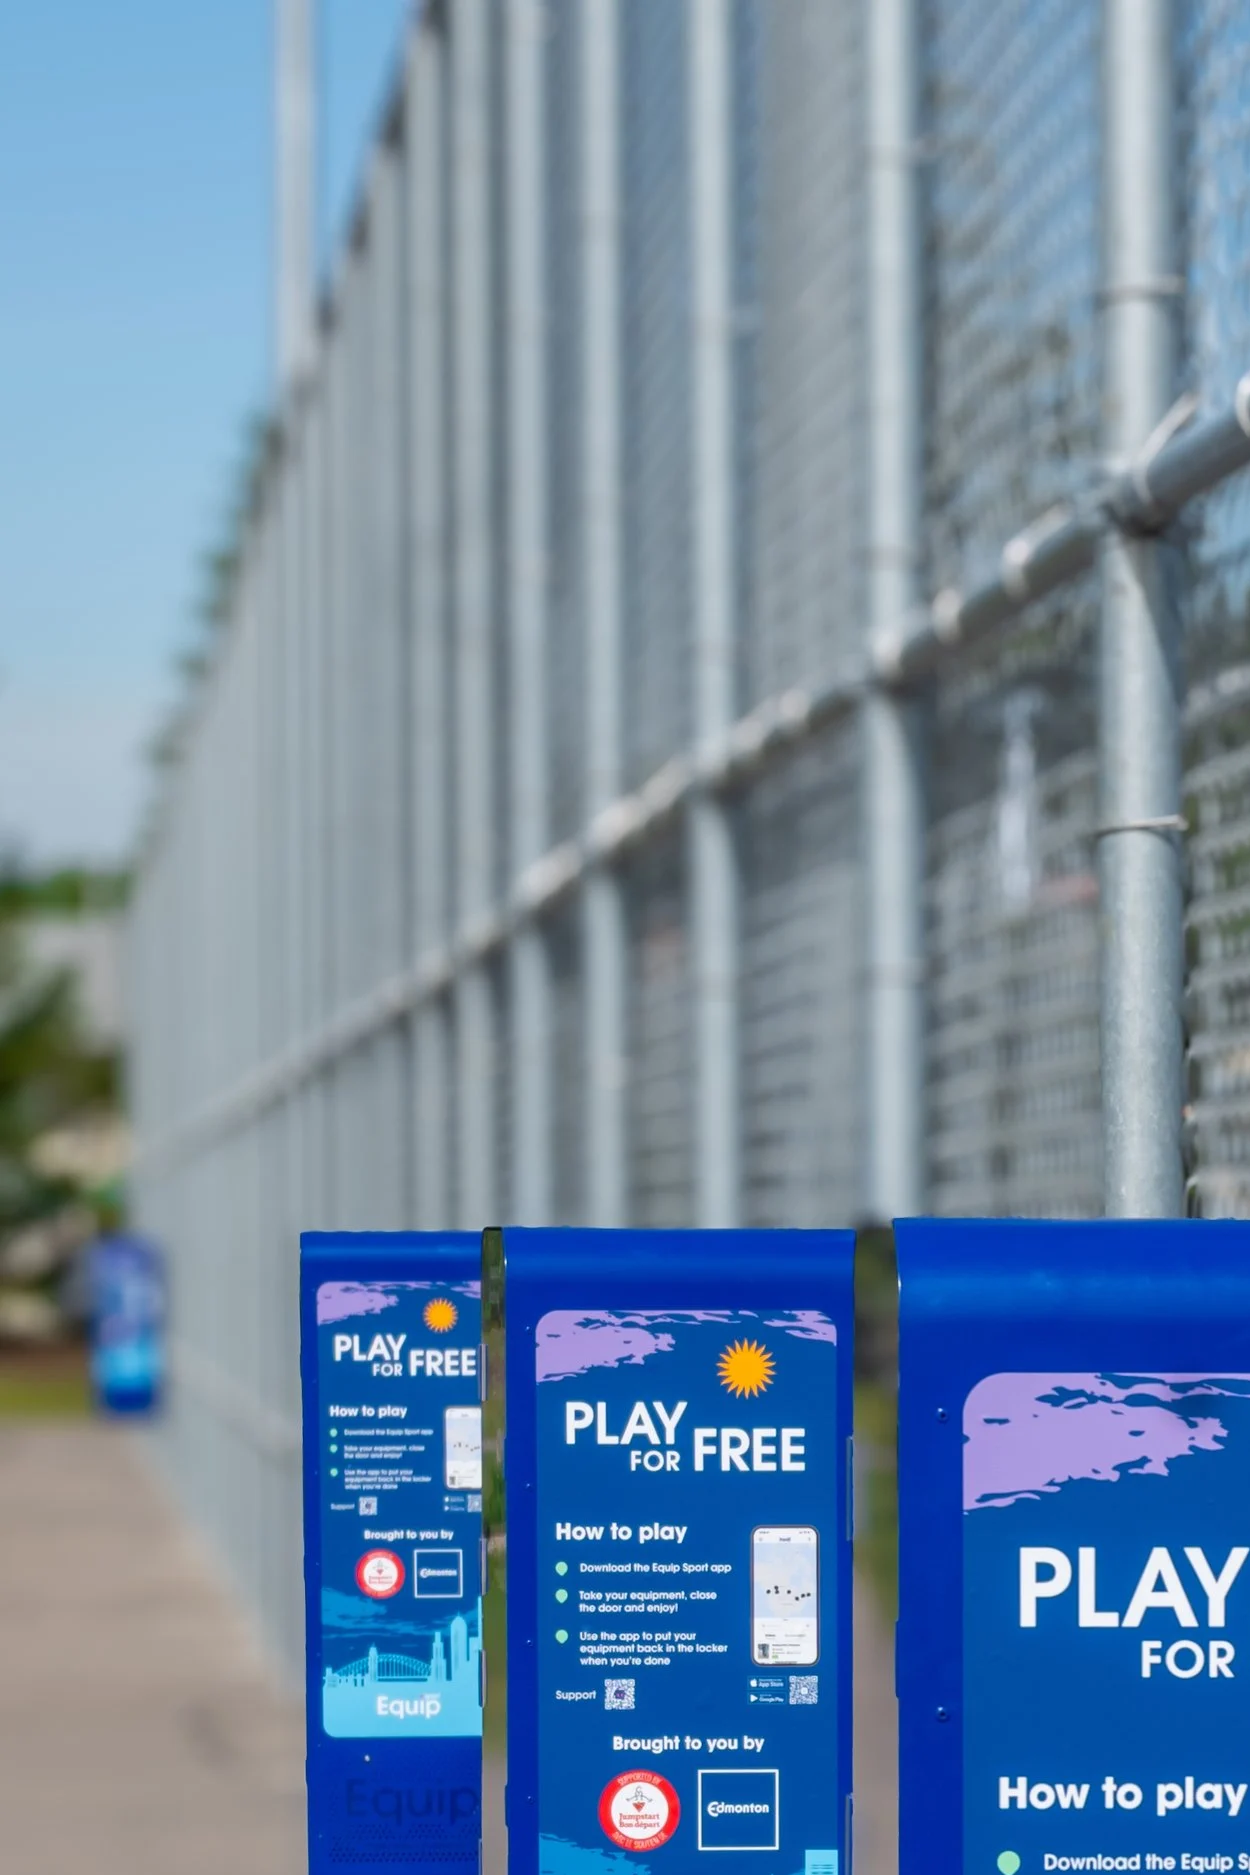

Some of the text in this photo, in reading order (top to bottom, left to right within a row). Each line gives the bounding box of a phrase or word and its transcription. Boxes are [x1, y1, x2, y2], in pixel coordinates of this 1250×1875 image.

[334, 1333, 407, 1361] PLAY
[372, 1349, 476, 1376] FOR FREE
[329, 1405, 407, 1418] How to play
[566, 1401, 687, 1444] PLAY
[630, 1428, 805, 1472] FOR FREE
[364, 1529, 454, 1542] Brought to you by
[556, 1522, 687, 1544] How to play
[580, 1563, 732, 1574] Download the Equip Sport app
[579, 1590, 717, 1602] Take your equipment, close
[1020, 1547, 1250, 1627] PLAY
[579, 1603, 678, 1614] the door and enjoy!
[580, 1632, 696, 1642] Use the app to put your
[580, 1644, 728, 1654] equipment back in the locker
[580, 1656, 608, 1665] when
[644, 1656, 670, 1665] done
[1142, 1640, 1235, 1678] FOR
[556, 1690, 596, 1701] Support
[376, 1694, 441, 1719] Equip
[613, 1736, 764, 1754] Brought to you by
[999, 1776, 1248, 1816] How to play
[707, 1801, 769, 1817] Edmonton
[1044, 1854, 1140, 1870] Download
[1145, 1854, 1176, 1870] the
[1181, 1853, 1234, 1873] Equip
